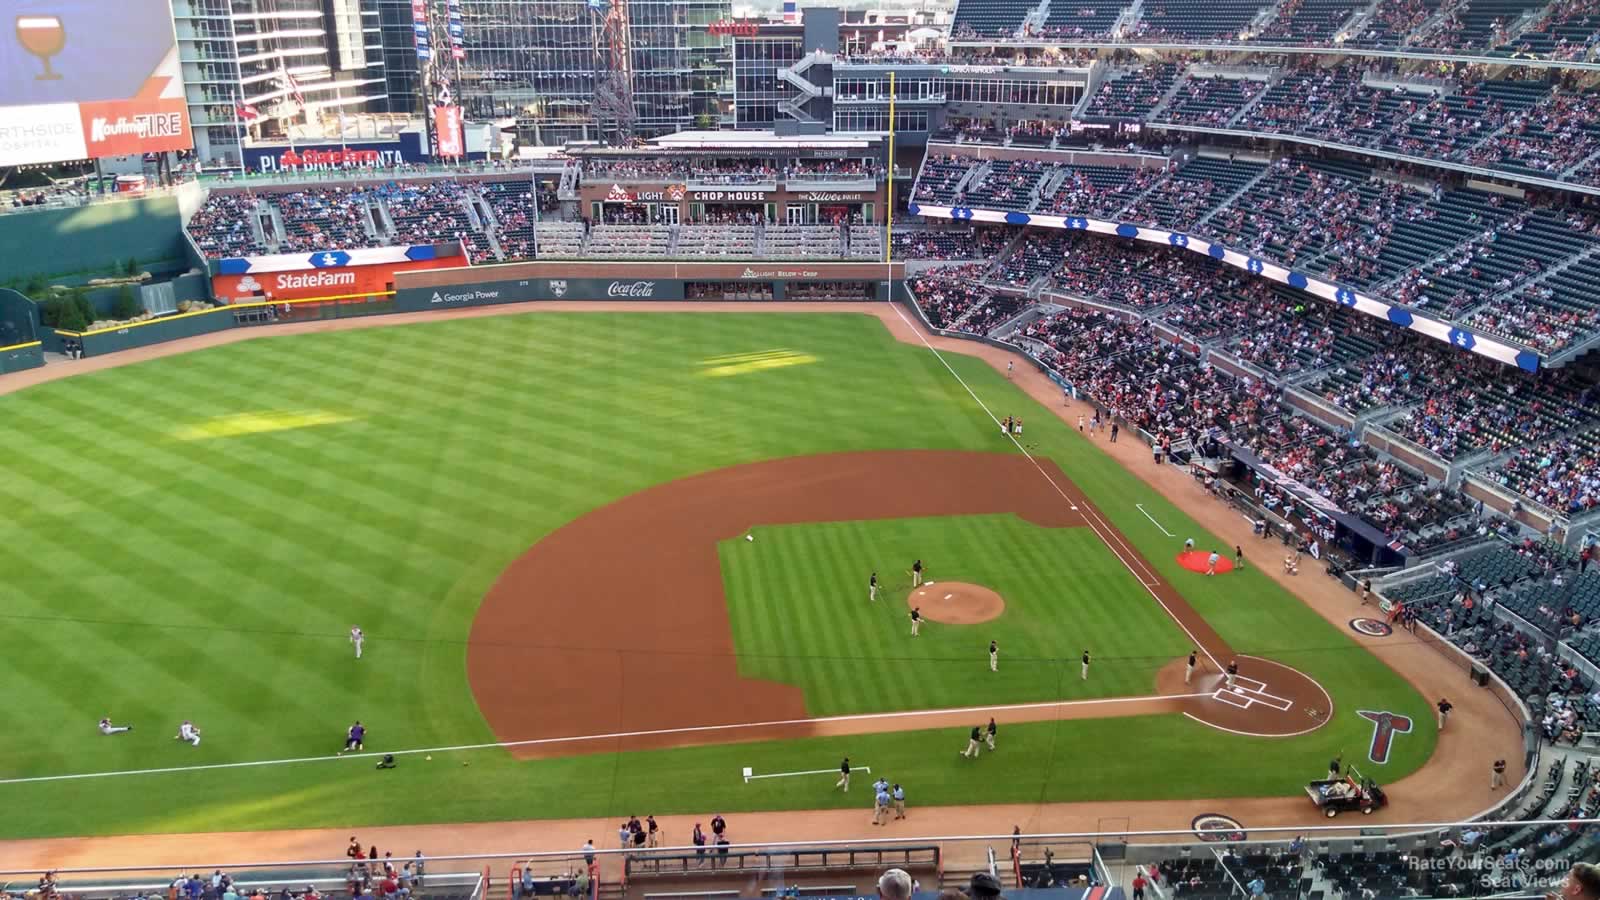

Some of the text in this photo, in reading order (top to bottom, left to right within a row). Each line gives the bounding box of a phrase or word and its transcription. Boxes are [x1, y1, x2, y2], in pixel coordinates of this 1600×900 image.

[708, 16, 758, 42] xfinity
[134, 112, 182, 138] TIRE
[637, 192, 664, 200] LIGHT
[694, 191, 765, 200] CHOP HOUSE
[809, 191, 841, 201] Silver
[277, 271, 355, 289] StateFarm
[444, 290, 499, 301] Georgia Power
[608, 281, 655, 297] Coca-Cola
